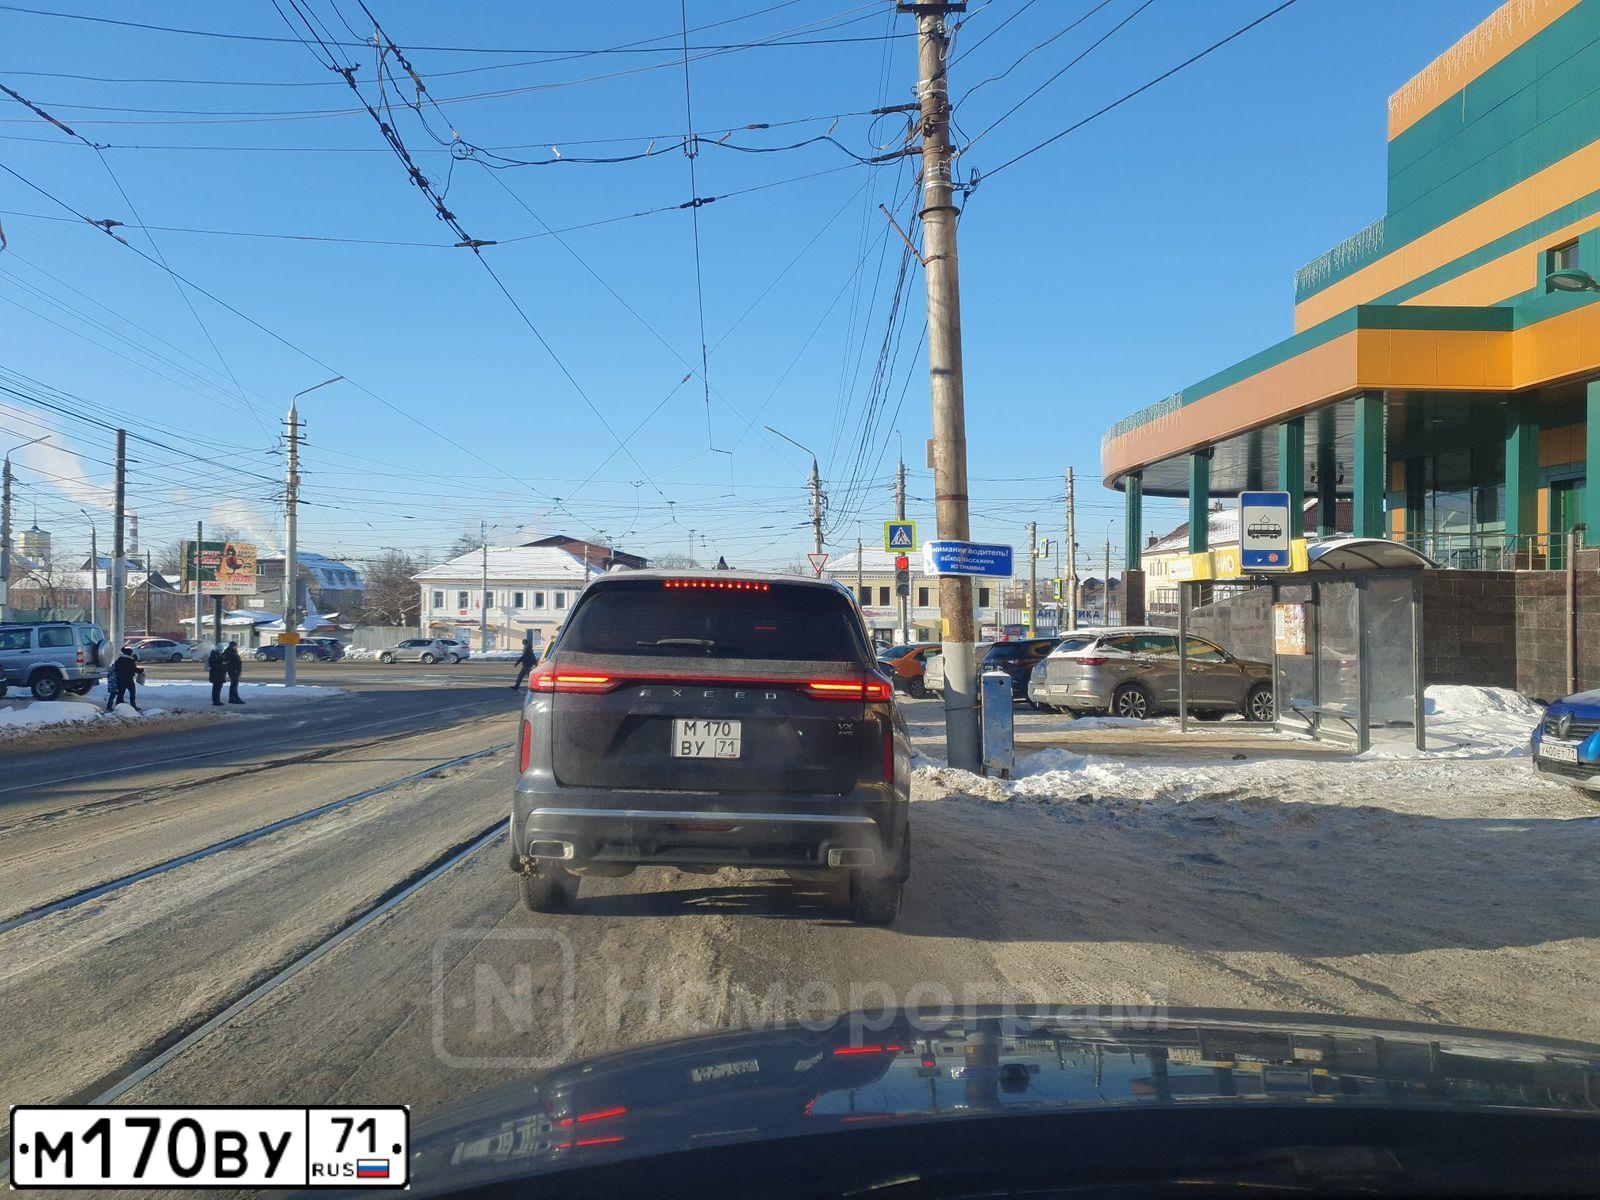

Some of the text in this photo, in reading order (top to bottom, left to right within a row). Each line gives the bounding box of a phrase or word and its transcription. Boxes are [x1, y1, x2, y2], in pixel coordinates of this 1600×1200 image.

[929, 546, 967, 554] нимание
[639, 689, 777, 700] EXEED
[683, 721, 731, 737] М 170
[681, 740, 735, 756] ВУ 71
